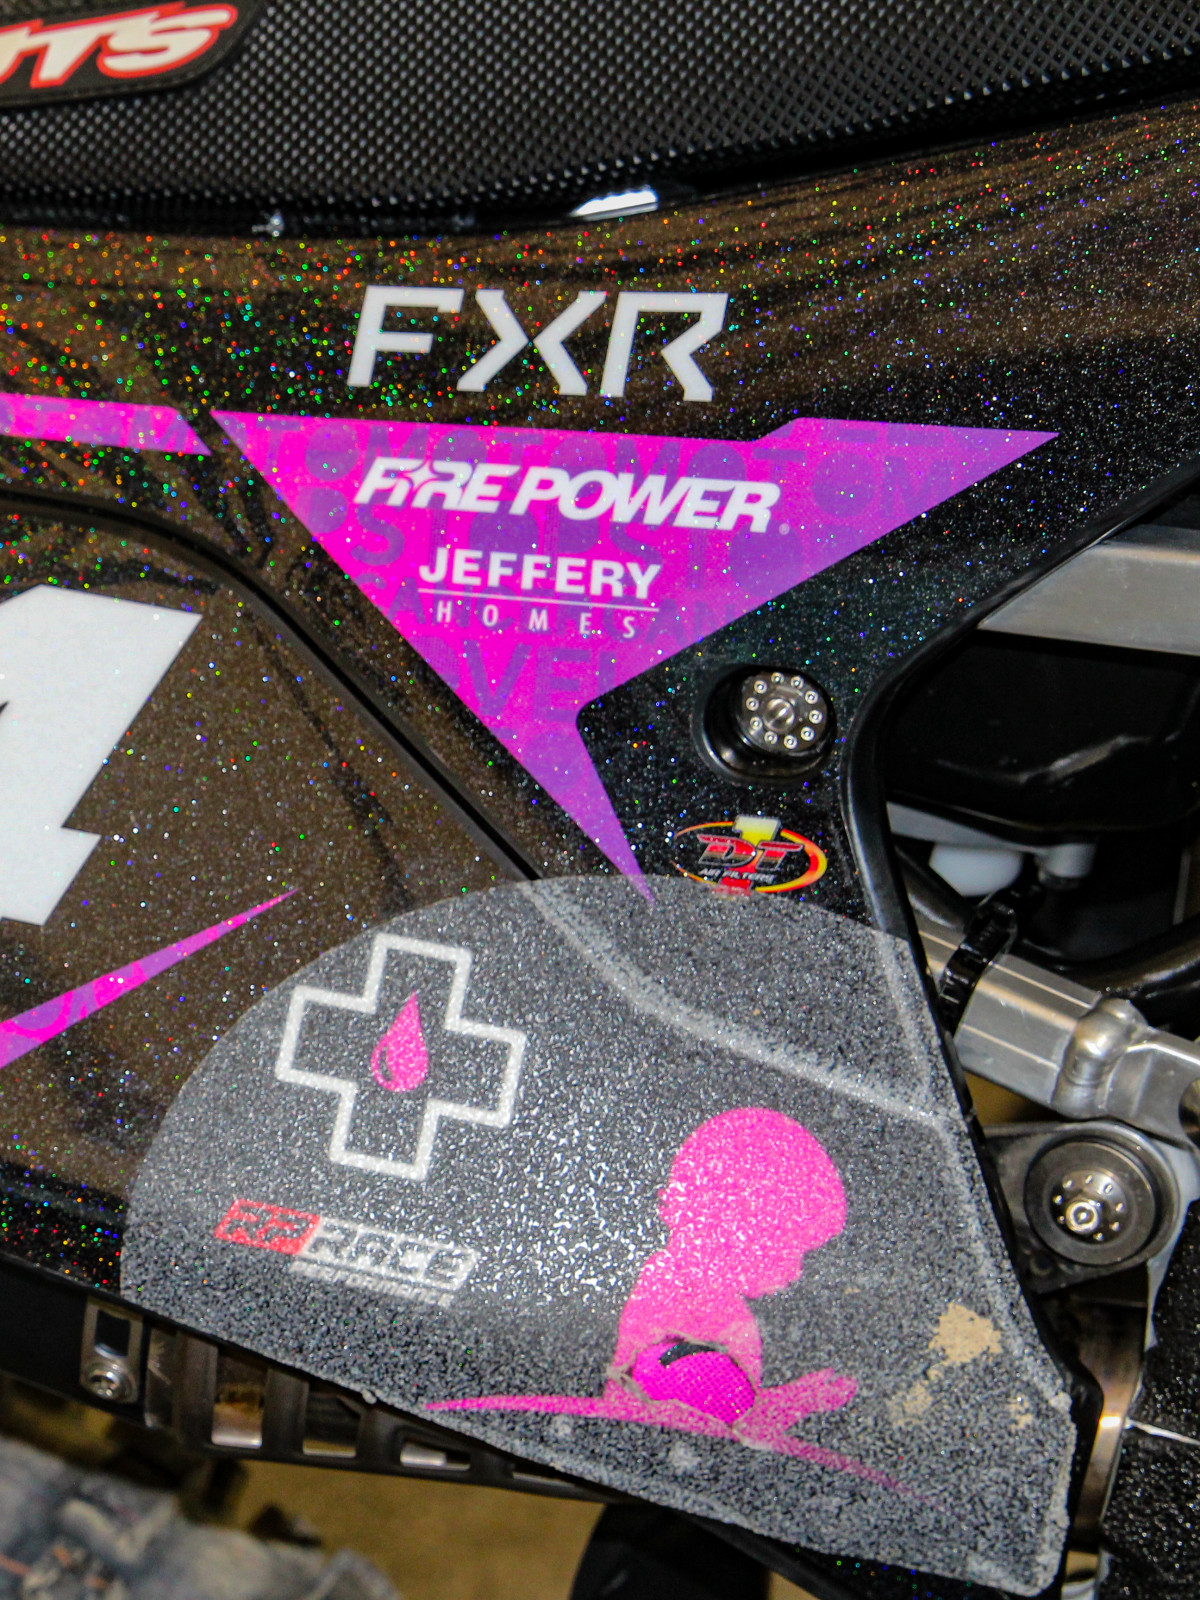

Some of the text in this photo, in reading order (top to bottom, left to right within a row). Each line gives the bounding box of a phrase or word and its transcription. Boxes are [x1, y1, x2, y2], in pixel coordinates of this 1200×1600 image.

[347, 285, 728, 401] FXR
[353, 456, 782, 534] FIRE POWER
[418, 546, 662, 600] JEFFERY
[436, 600, 637, 640] HOMES
